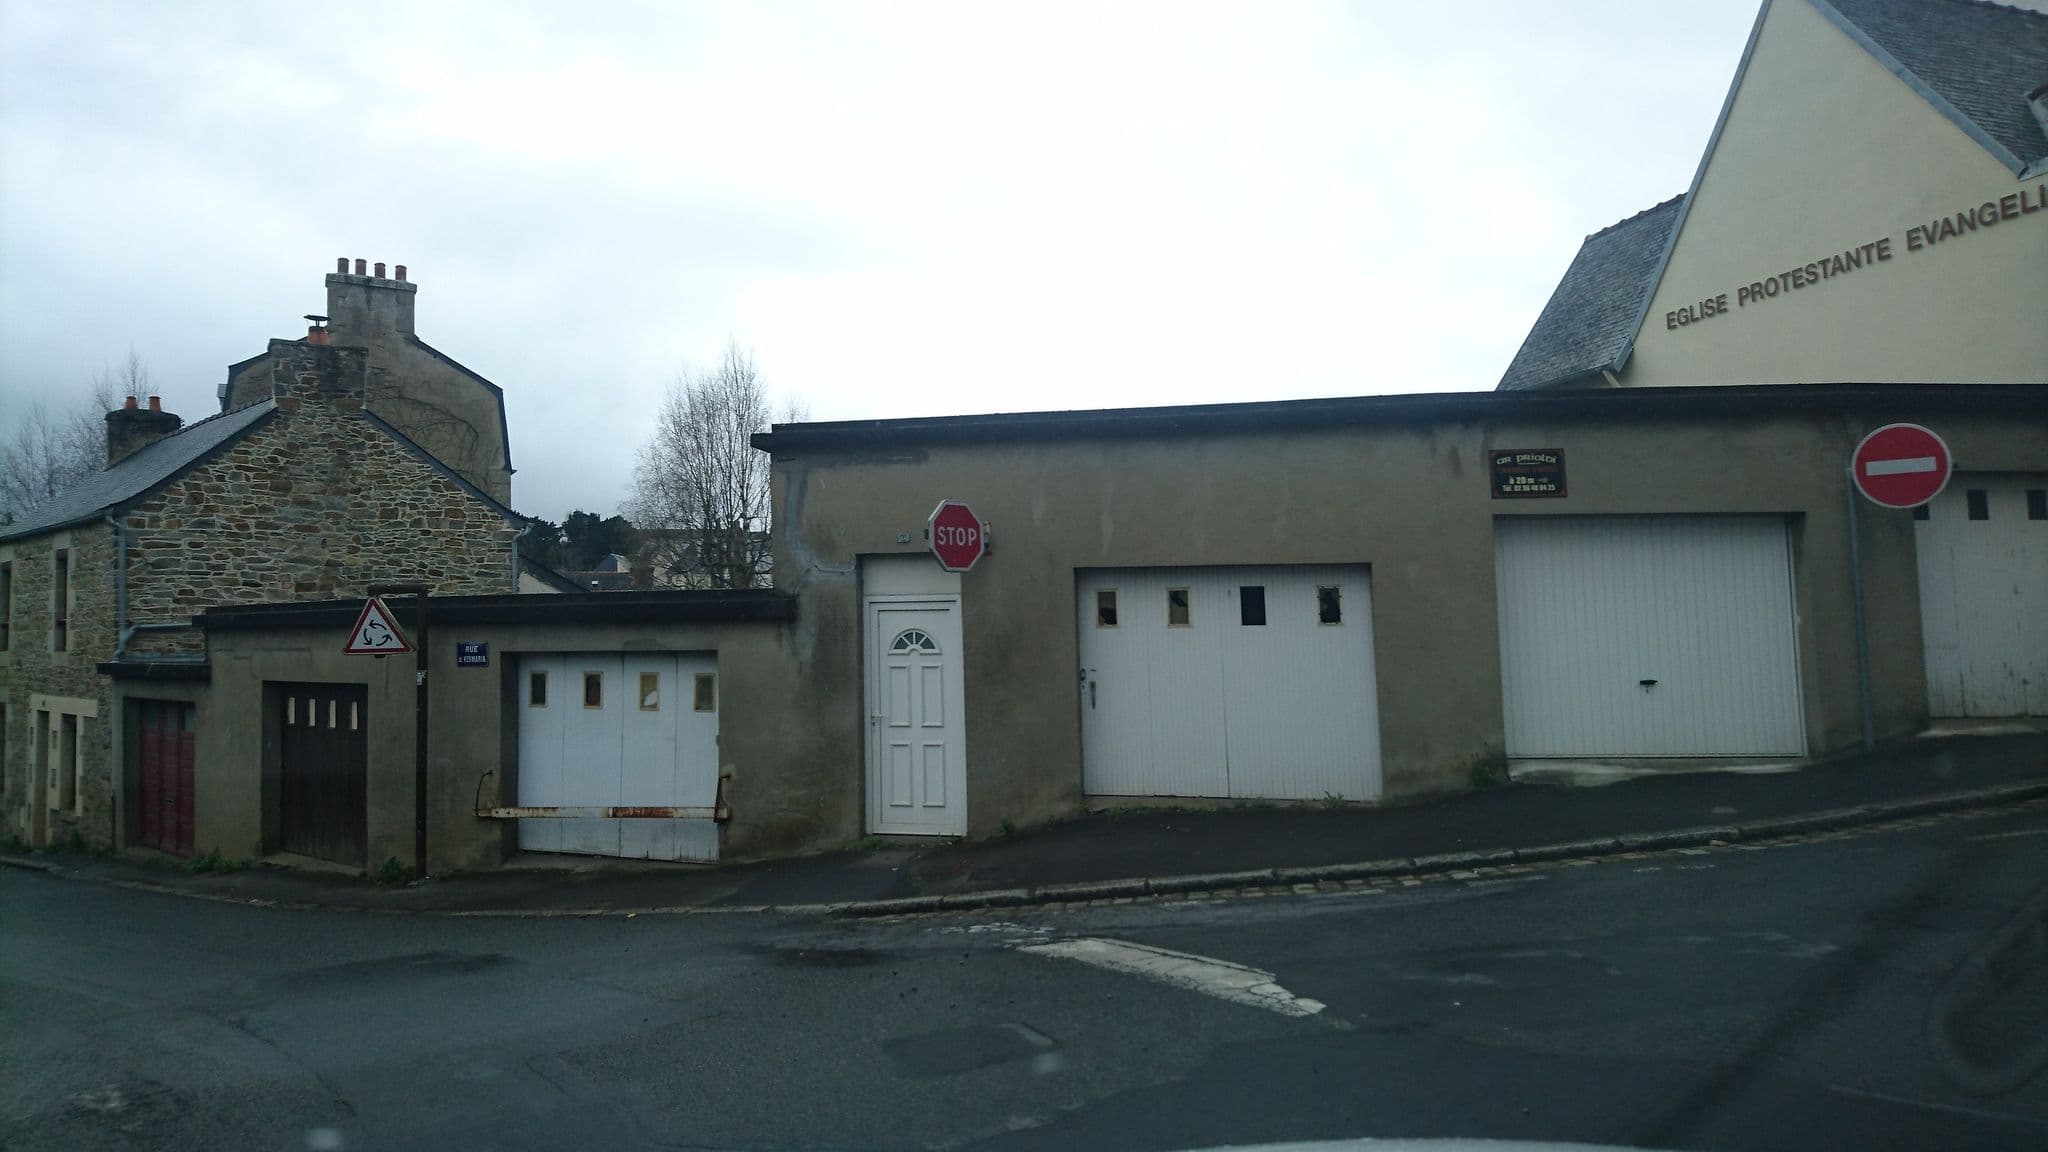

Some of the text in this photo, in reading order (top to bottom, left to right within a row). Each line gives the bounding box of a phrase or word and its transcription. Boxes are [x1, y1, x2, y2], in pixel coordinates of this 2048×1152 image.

[1665, 184, 2048, 330] EGLISE PROTESTANTE EVANGELI
[938, 526, 977, 546] STOP
